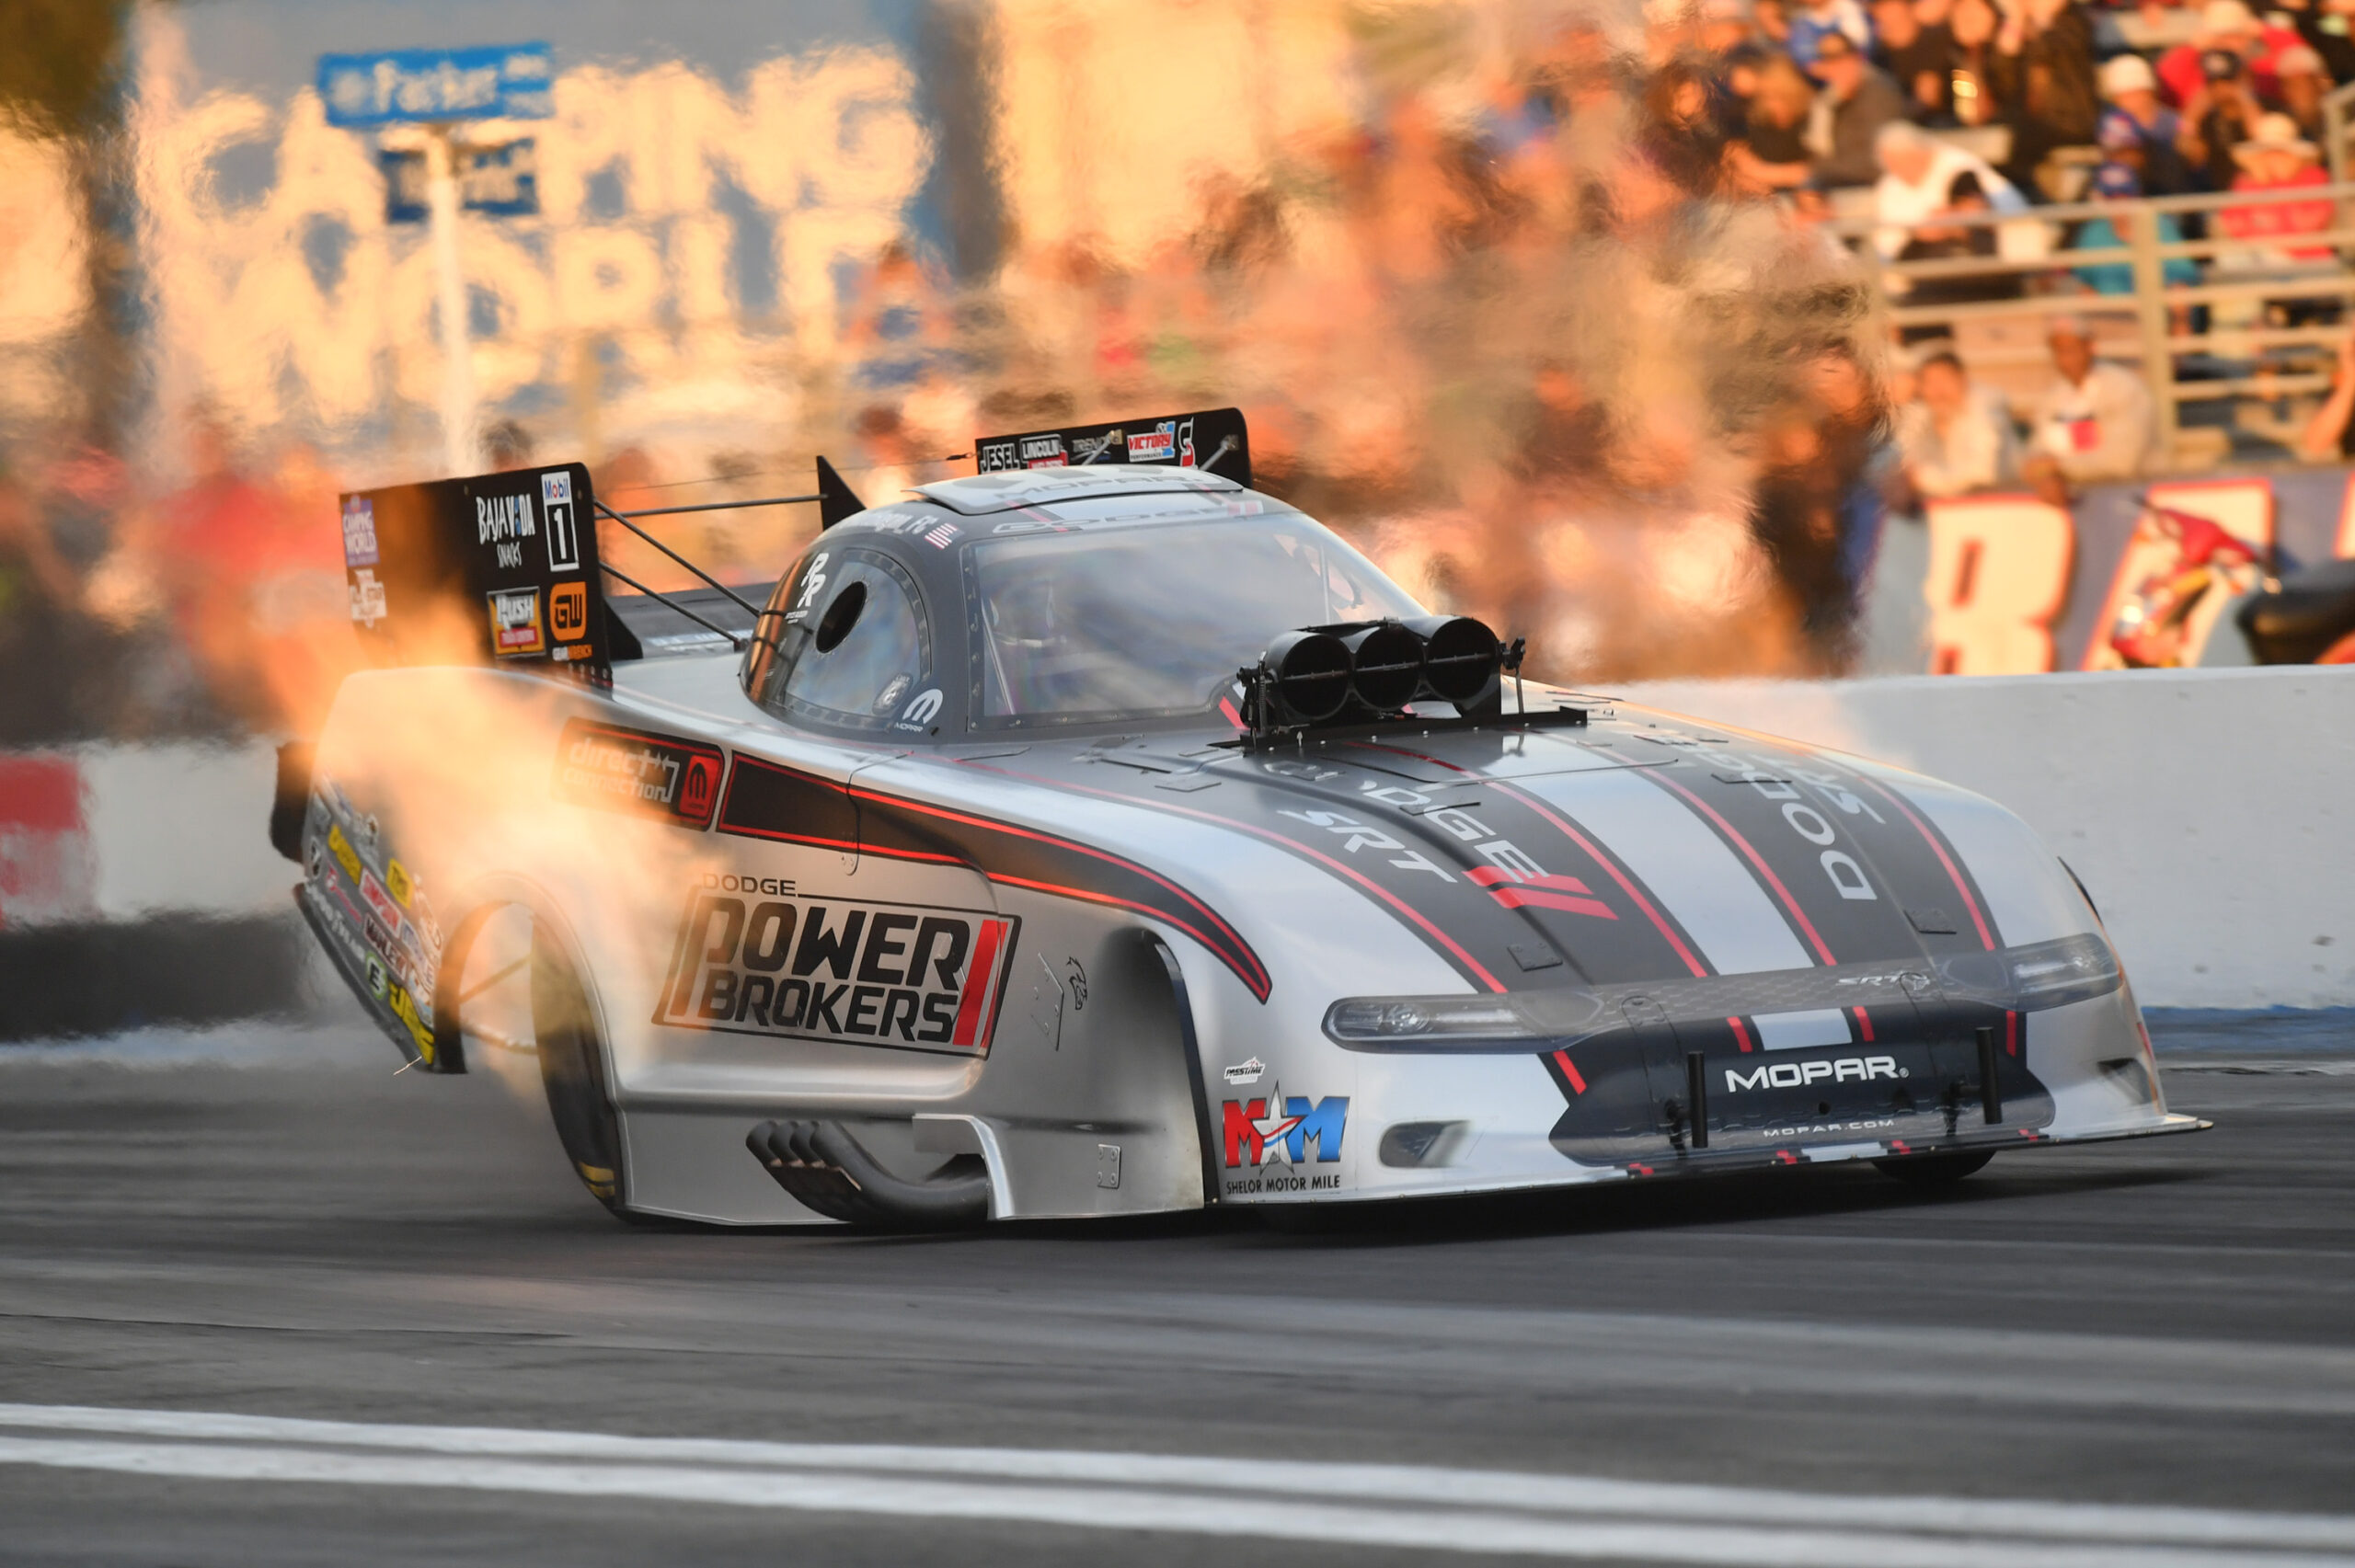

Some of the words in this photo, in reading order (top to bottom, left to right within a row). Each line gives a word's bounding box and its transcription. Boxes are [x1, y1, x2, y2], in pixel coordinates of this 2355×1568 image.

[175, 46, 931, 224] CAPING
[979, 442, 1020, 474] JESEL
[1127, 433, 1172, 451] VICTORY
[545, 478, 570, 498] Mobil
[553, 508, 567, 560] 1
[569, 737, 657, 778] direct
[564, 765, 673, 804] connection
[1277, 810, 1458, 883] SRT
[702, 873, 798, 898] DODGE
[677, 895, 971, 998] POWER
[697, 967, 961, 1043] BROKERS
[1763, 1119, 1895, 1139] MOPAR.COM
[1226, 1178, 1263, 1196] SHELOR
[1266, 1175, 1307, 1193] MOTOR
[1311, 1173, 1341, 1190] MILE
